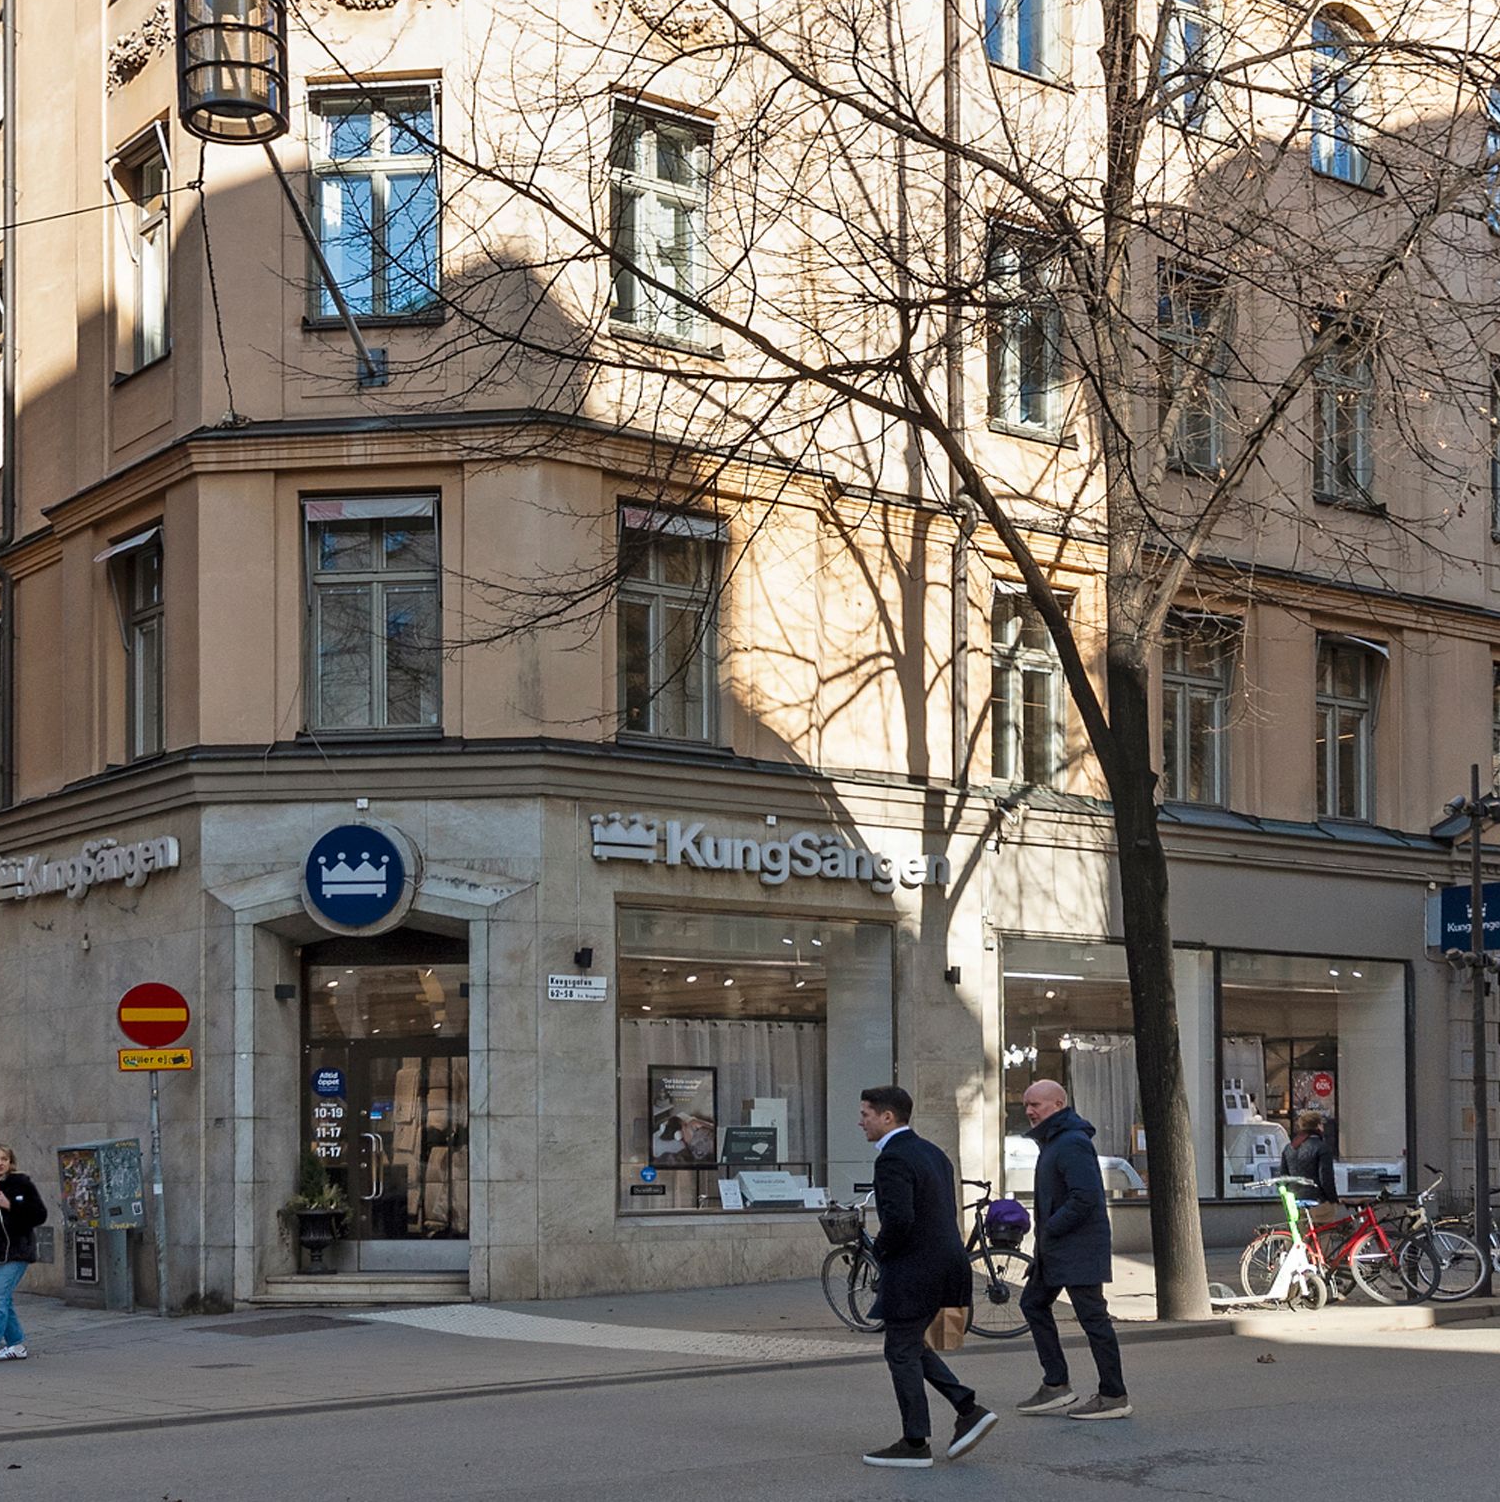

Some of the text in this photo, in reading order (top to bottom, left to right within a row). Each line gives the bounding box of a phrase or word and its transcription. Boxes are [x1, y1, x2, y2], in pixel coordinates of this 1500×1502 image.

[665, 820, 951, 895] KungSängen
[24, 835, 180, 898] KungSängen
[157, 1055, 168, 1065] ej
[314, 1107, 344, 1118] 10-19
[316, 1127, 341, 1138] 11-17
[317, 1147, 341, 1158] 11-17
